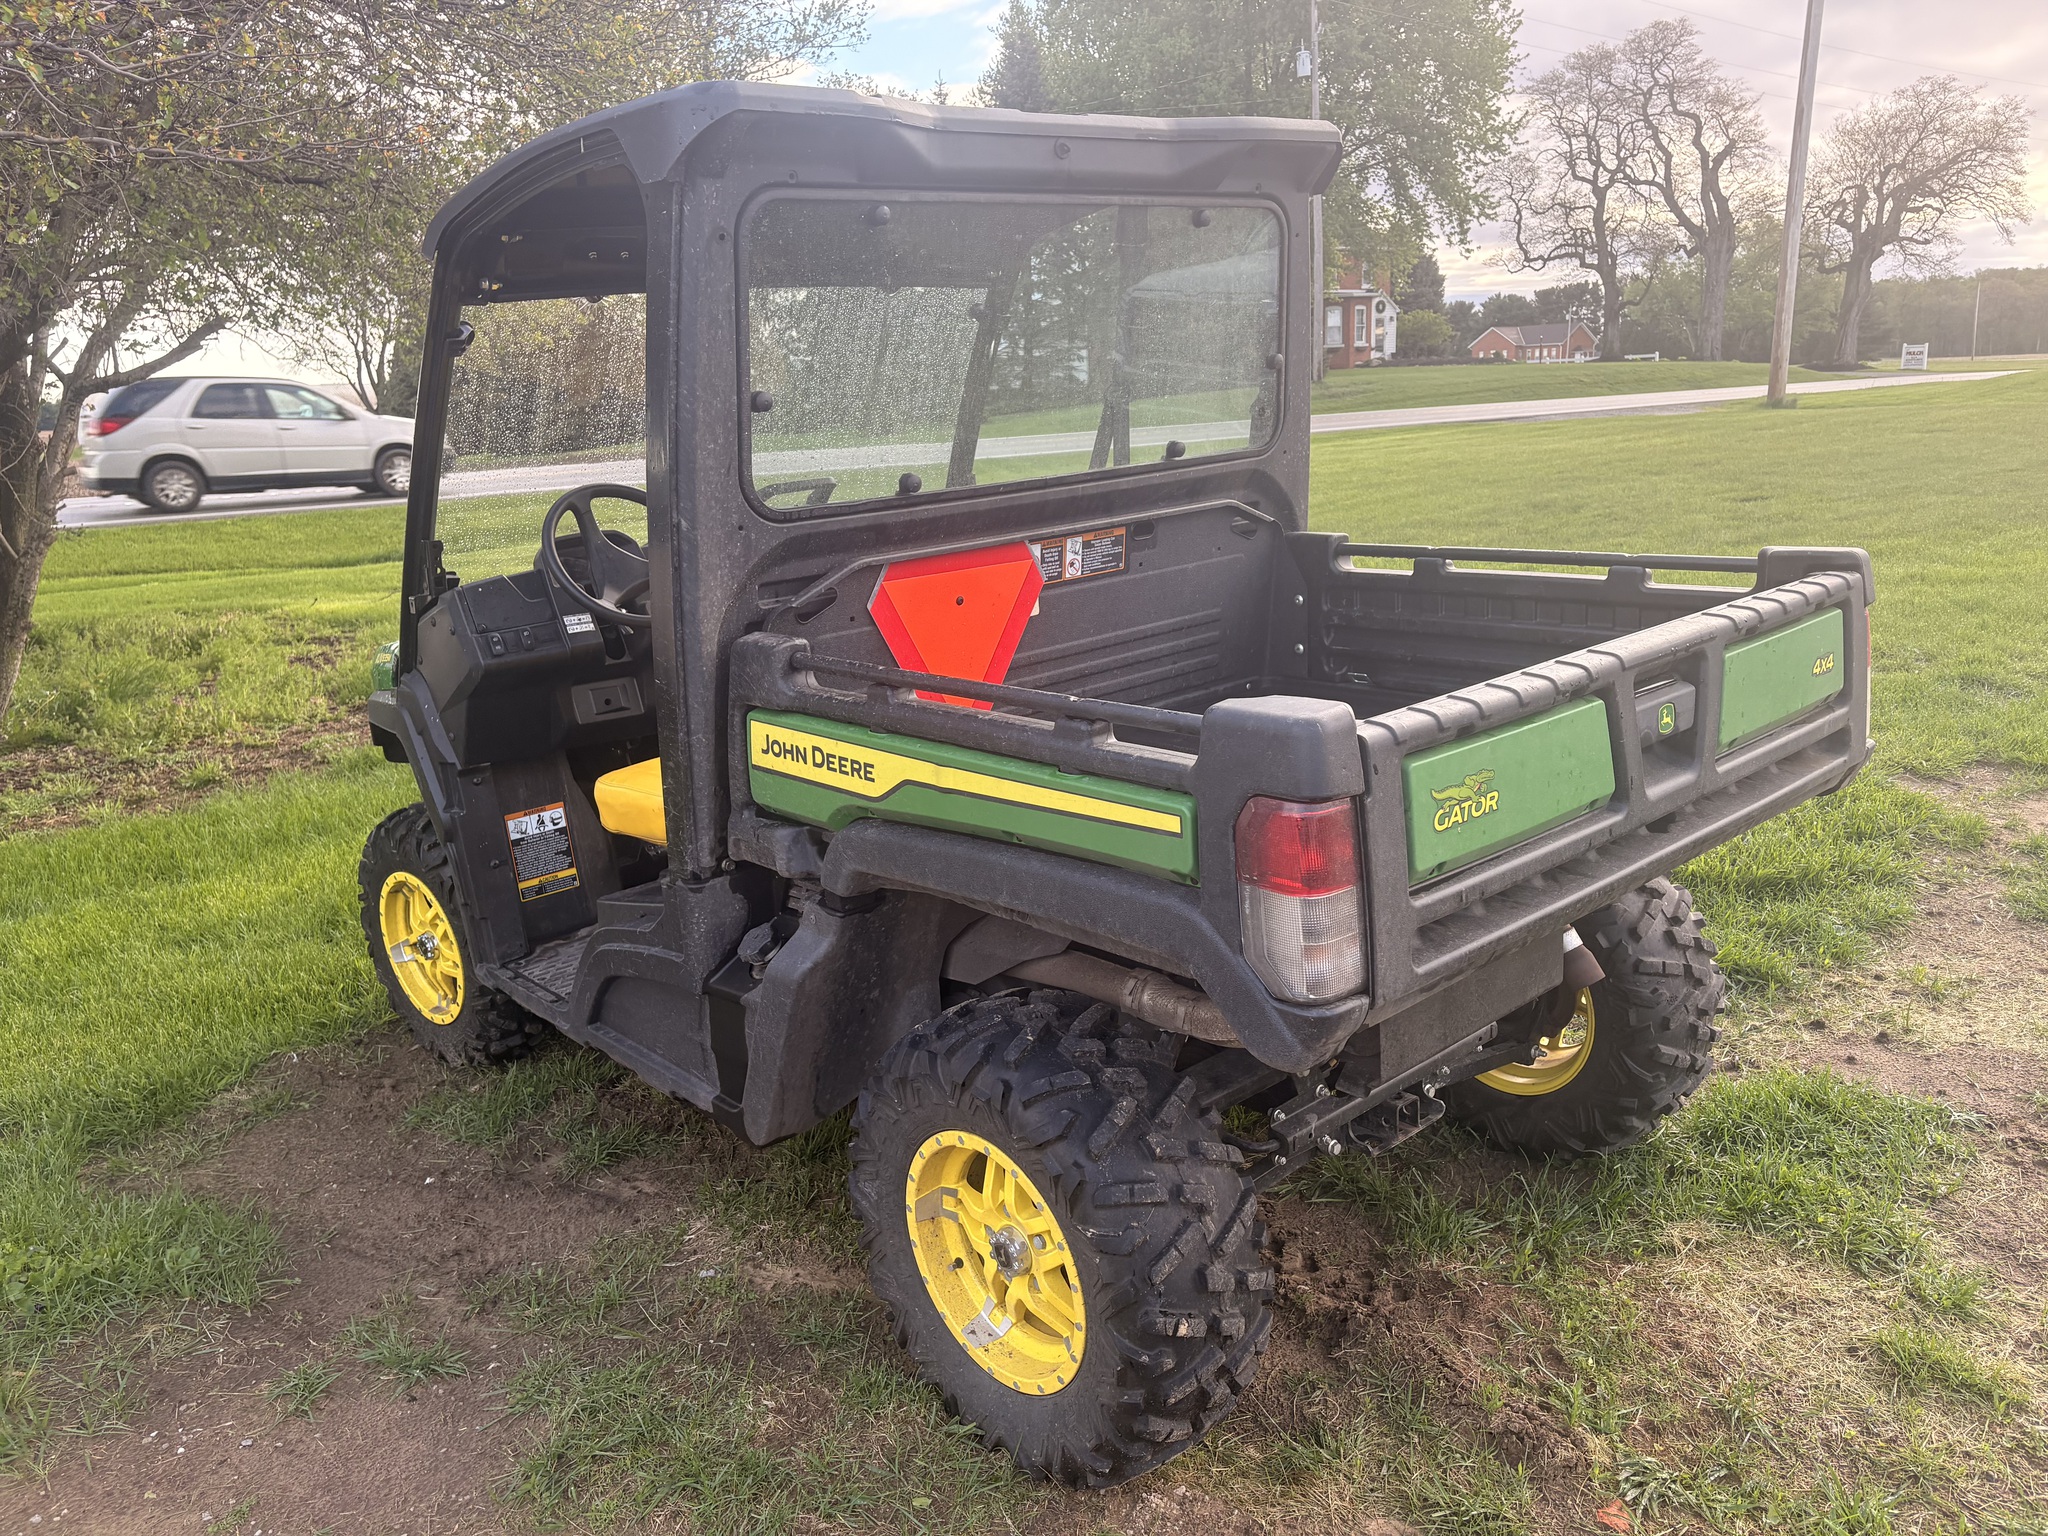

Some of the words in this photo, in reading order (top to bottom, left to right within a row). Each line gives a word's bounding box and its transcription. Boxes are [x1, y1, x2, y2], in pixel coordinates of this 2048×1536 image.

[761, 734, 808, 765] JOHN
[811, 746, 875, 783] DEERE
[1434, 790, 1499, 832] GATOR
